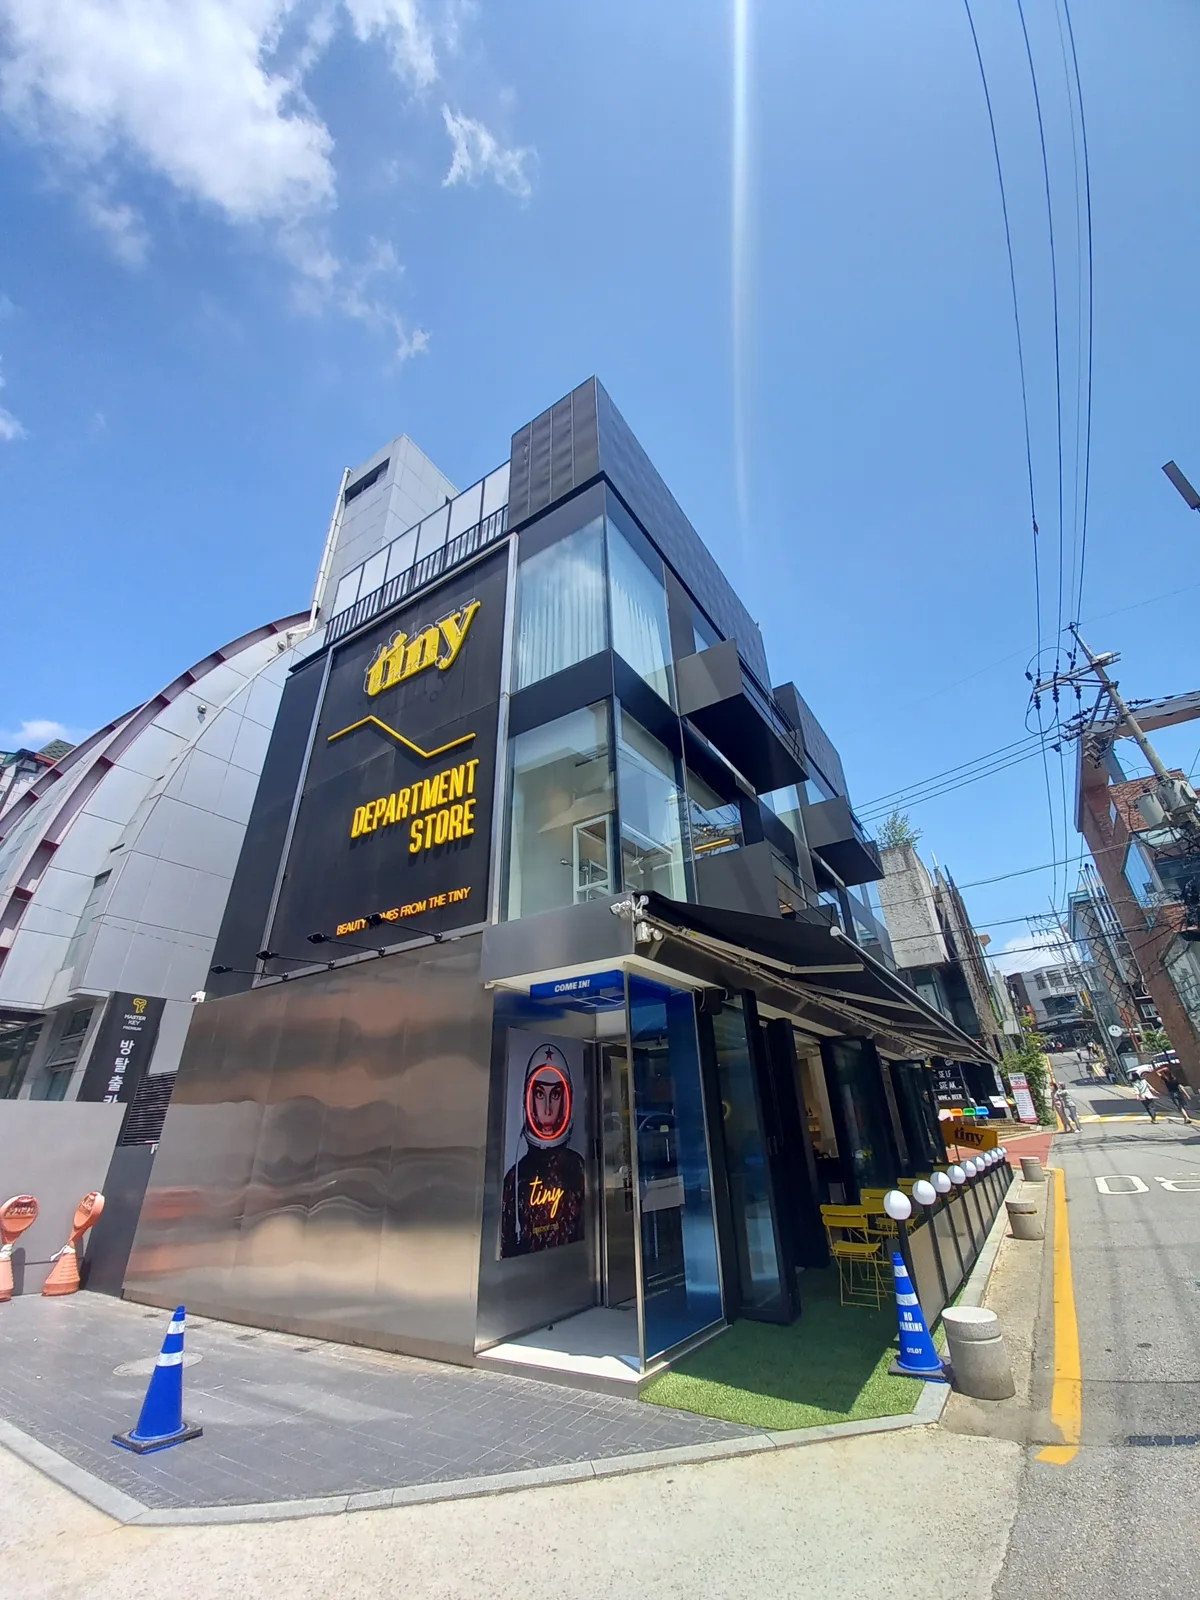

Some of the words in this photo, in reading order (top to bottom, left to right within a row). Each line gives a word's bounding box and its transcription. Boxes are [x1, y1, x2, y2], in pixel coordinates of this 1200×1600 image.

[363, 598, 481, 697] tiny
[351, 758, 480, 838] DEPARTMENT
[409, 798, 477, 854] STORE
[336, 918, 367, 936] BEAUTY
[400, 900, 427, 918] FROM
[428, 893, 447, 909] THE
[447, 886, 472, 903] TINY
[554, 981, 578, 993] COME
[578, 979, 591, 989] IN!
[954, 1126, 985, 1146] tiny
[529, 1175, 565, 1220] tiny
[899, 1321, 923, 1332] PARKING
[903, 1311, 913, 1322] NO
